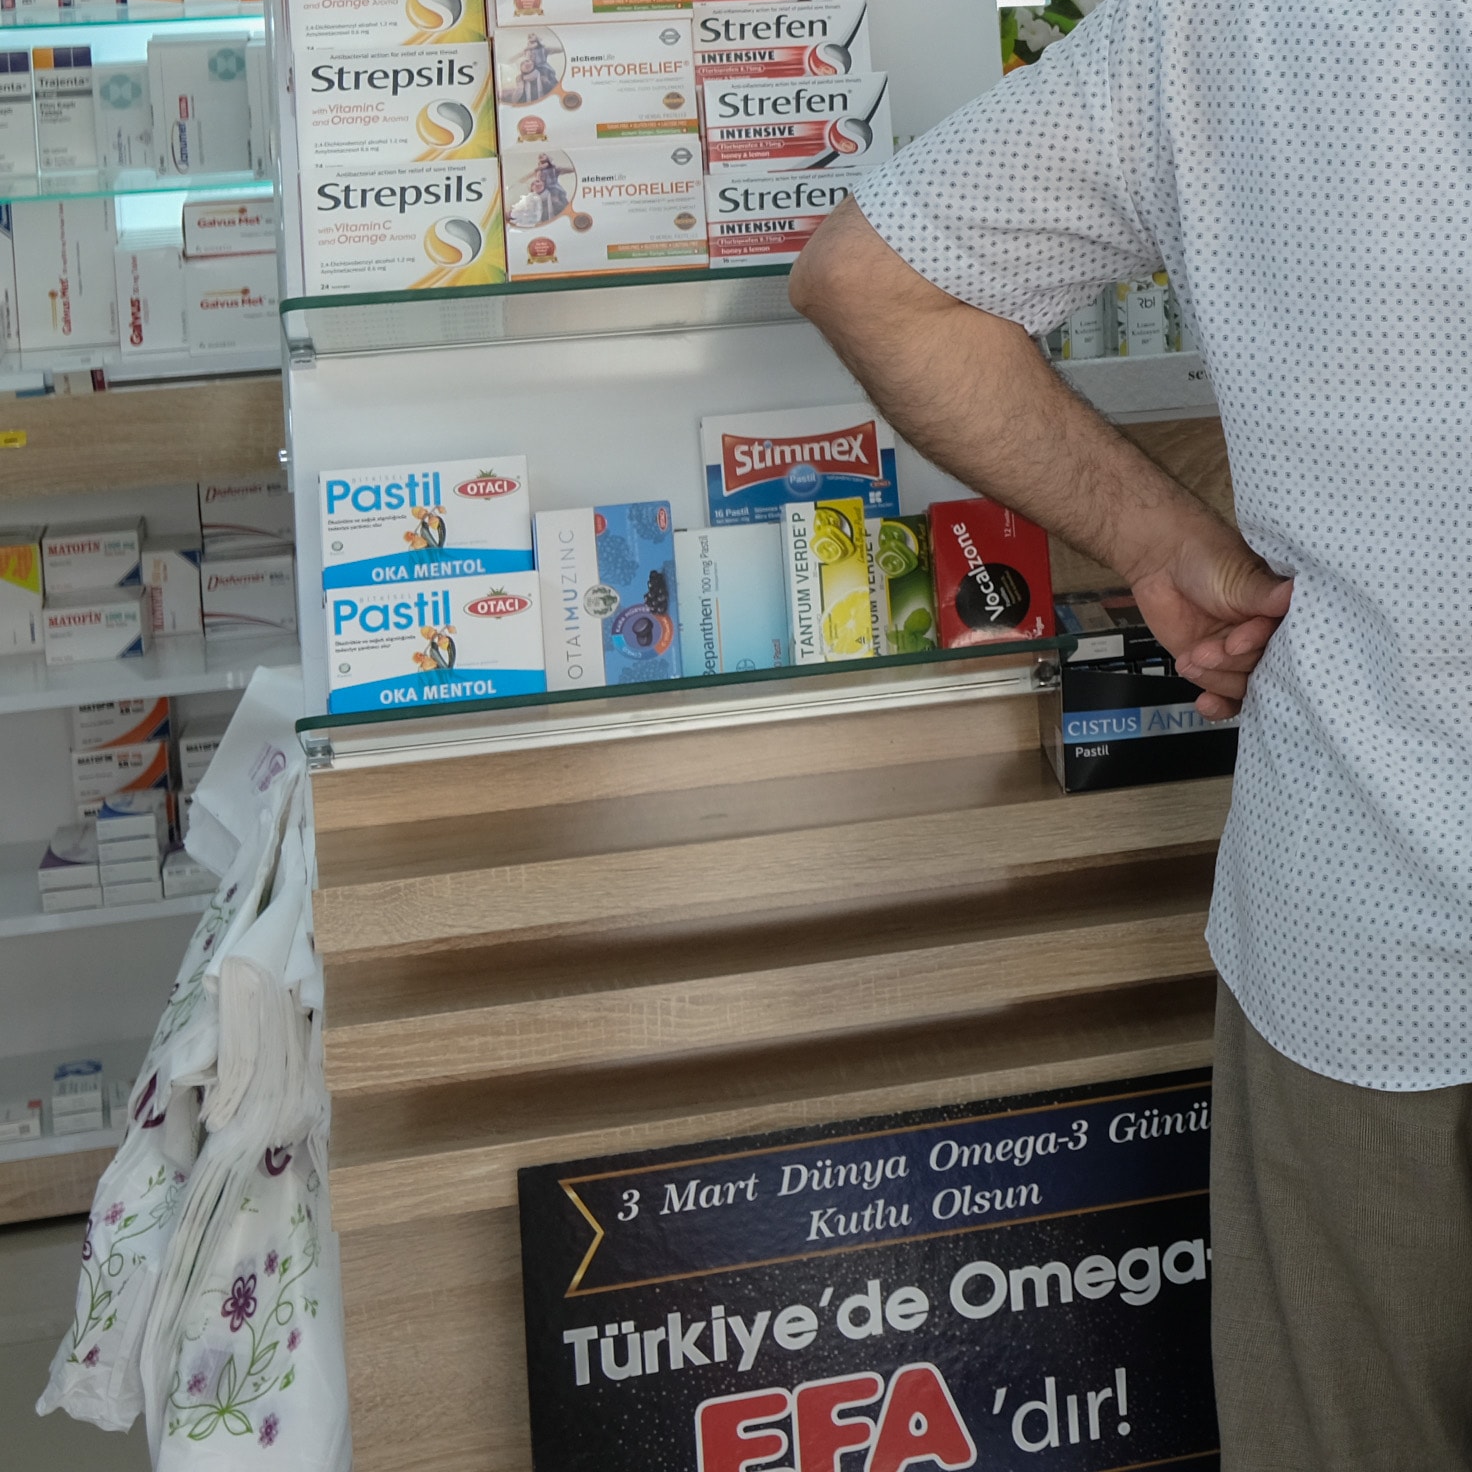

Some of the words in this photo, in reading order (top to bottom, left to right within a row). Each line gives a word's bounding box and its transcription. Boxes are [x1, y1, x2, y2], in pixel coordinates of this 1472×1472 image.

[700, 14, 828, 43] Strefen
[701, 50, 775, 64] INTENSIVE
[311, 59, 475, 96] Strepsils
[571, 61, 683, 78] PHYTORELIEF
[39, 77, 86, 88] Trajenta
[718, 89, 848, 118] Strefen
[720, 126, 795, 140] INTENSIVE
[317, 175, 483, 214] Strepsils
[582, 181, 695, 198] PHYTORELIEF
[718, 183, 848, 213] Strefen
[197, 216, 237, 228] Galvus
[238, 214, 260, 226] Met
[720, 220, 795, 234] INTENSIVE
[200, 298, 240, 310] Galvus
[241, 296, 263, 307] Met
[130, 297, 143, 347] Galvus
[734, 434, 869, 476] Stimmex
[467, 482, 509, 495] OTACI
[789, 472, 817, 484] Pastil
[326, 471, 441, 515] Pastil
[715, 509, 723, 518] 16
[725, 506, 750, 517] Pastil
[792, 512, 806, 522] P
[47, 541, 100, 556] MATOFİN
[699, 535, 710, 558] Pastil
[703, 560, 713, 575] mg
[792, 532, 809, 585] VERDE
[372, 566, 409, 582] OKA
[414, 559, 485, 579] MENTOL
[952, 522, 1004, 622] Vocalzone
[702, 579, 711, 594] 100
[333, 590, 451, 636] Pastil
[477, 600, 519, 614] OTACI
[793, 587, 815, 659] TANTUM
[699, 597, 719, 677] Bepanthen
[380, 688, 418, 705] OKA
[423, 680, 496, 701] MENTOL
[1068, 717, 1137, 737] CISTUS
[1075, 745, 1109, 758] Pastil
[616, 1188, 640, 1223] 3
[659, 1172, 760, 1217] Mart
[777, 1151, 910, 1200] Dünya
[928, 1119, 1090, 1175] Omega-3
[1108, 1100, 1212, 1145] Günü
[805, 1196, 913, 1243] Kutlu
[932, 1179, 1043, 1221] Olsun
[563, 1278, 930, 1388] Türkiye'de
[695, 1362, 977, 1472] EFA
